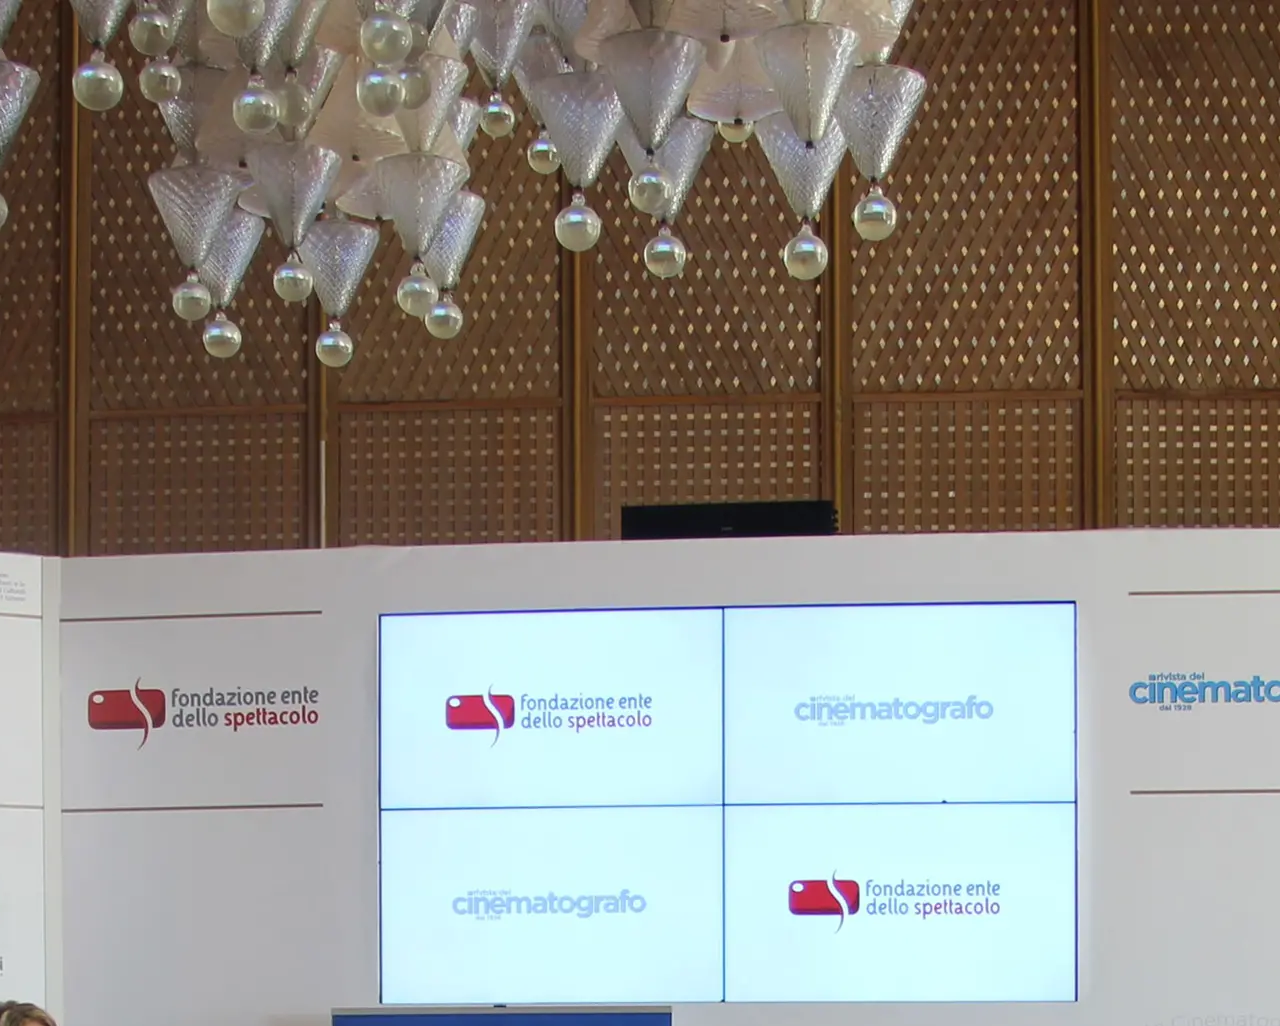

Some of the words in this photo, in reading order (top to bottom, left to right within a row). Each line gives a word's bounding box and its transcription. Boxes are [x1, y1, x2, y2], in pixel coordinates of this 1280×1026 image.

[1156, 673, 1186, 681] rivista
[1189, 672, 1205, 681] del
[172, 687, 276, 708] fondazione
[281, 686, 319, 704] ente
[521, 692, 615, 711] fondazione
[618, 692, 652, 709] ente
[172, 707, 219, 728] dello
[224, 707, 319, 732] spettacolo
[794, 695, 994, 725] cinematografo
[521, 712, 563, 729] dello
[568, 710, 652, 733] spettacolo
[866, 878, 962, 897] fondazione
[966, 880, 1000, 897] ente
[452, 889, 647, 919] cinematografo
[866, 898, 908, 915] dello
[915, 898, 1000, 920] spettacolo
